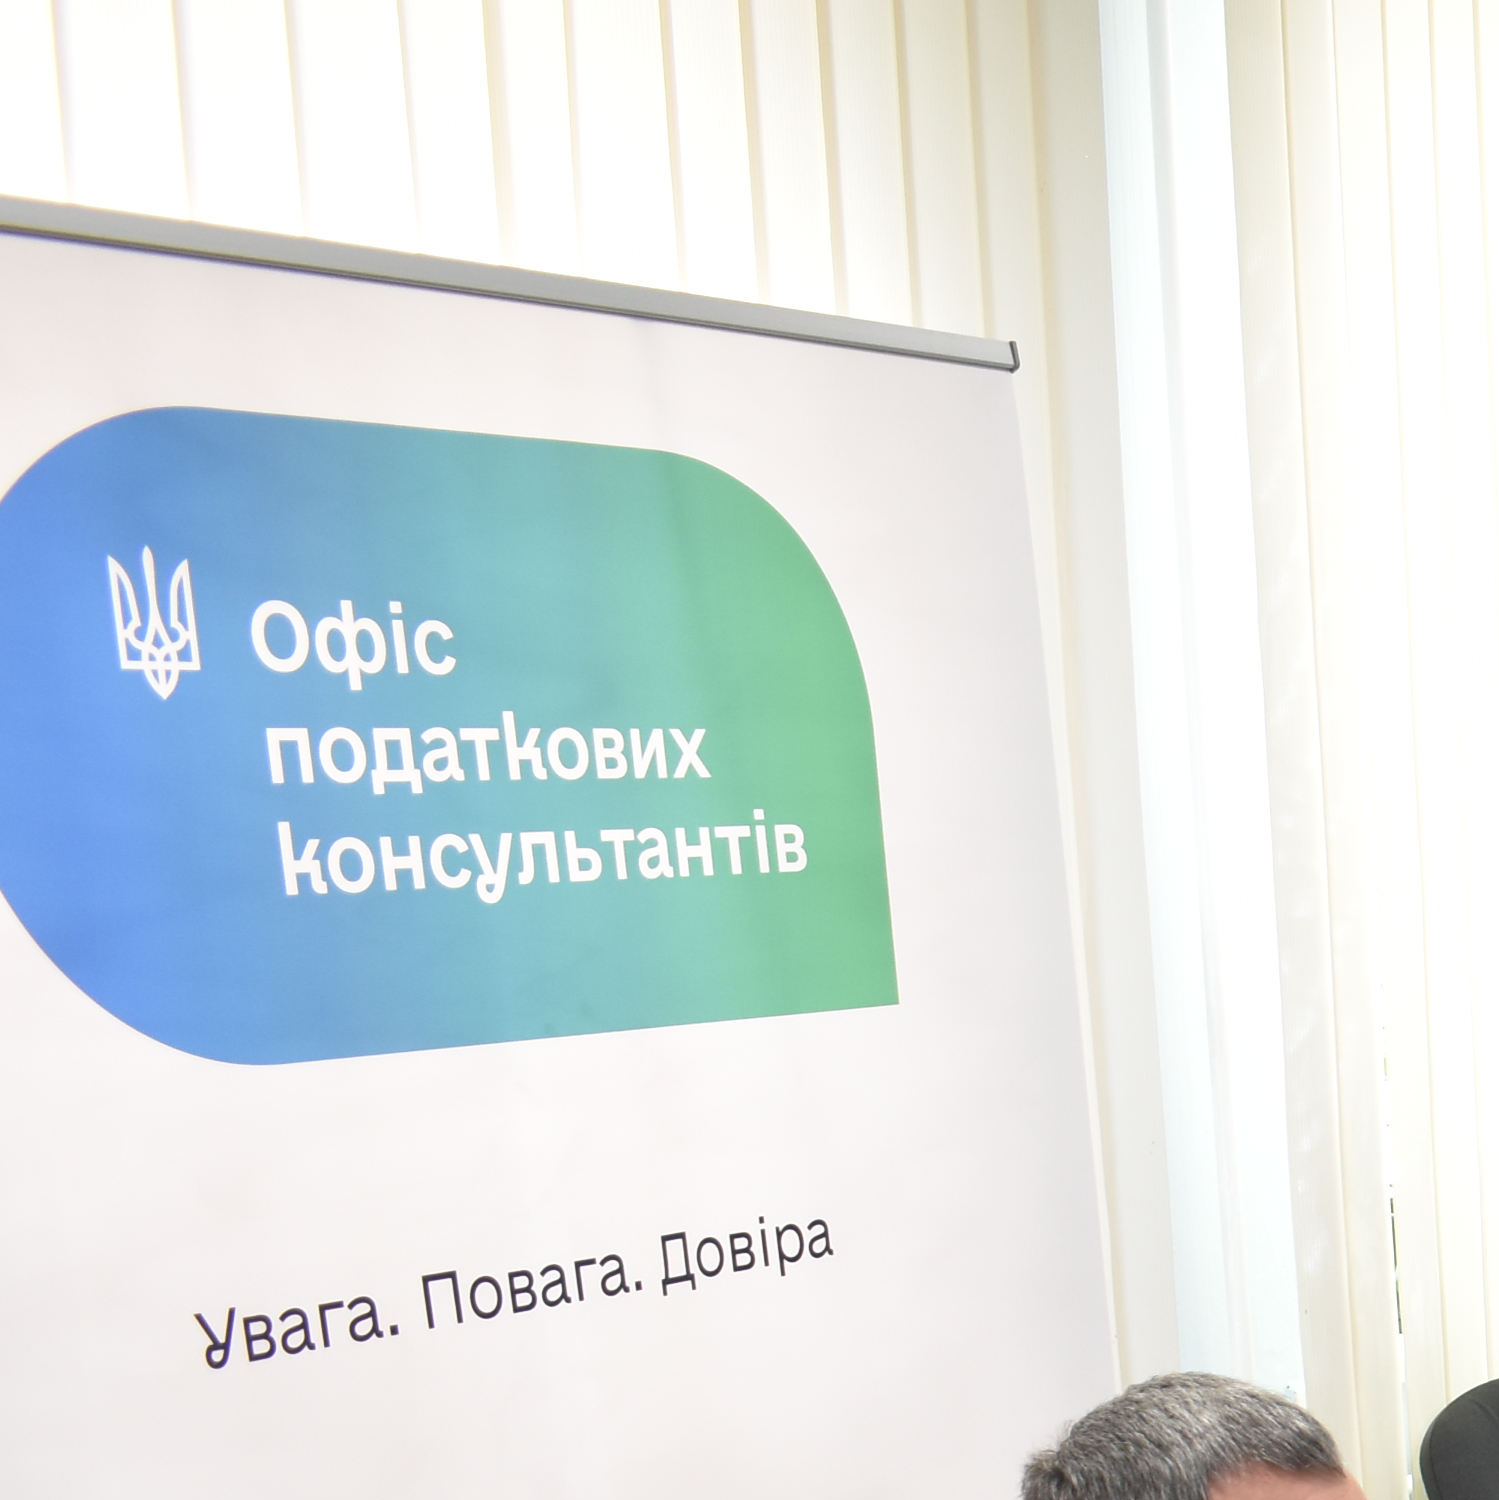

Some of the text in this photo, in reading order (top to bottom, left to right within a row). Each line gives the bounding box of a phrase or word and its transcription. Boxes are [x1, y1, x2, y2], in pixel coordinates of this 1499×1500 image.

[250, 599, 457, 691] Офіс
[265, 710, 712, 794] податкових
[277, 808, 809, 904] консультантів
[194, 1216, 834, 1370] Увага. Повага. Довіра
